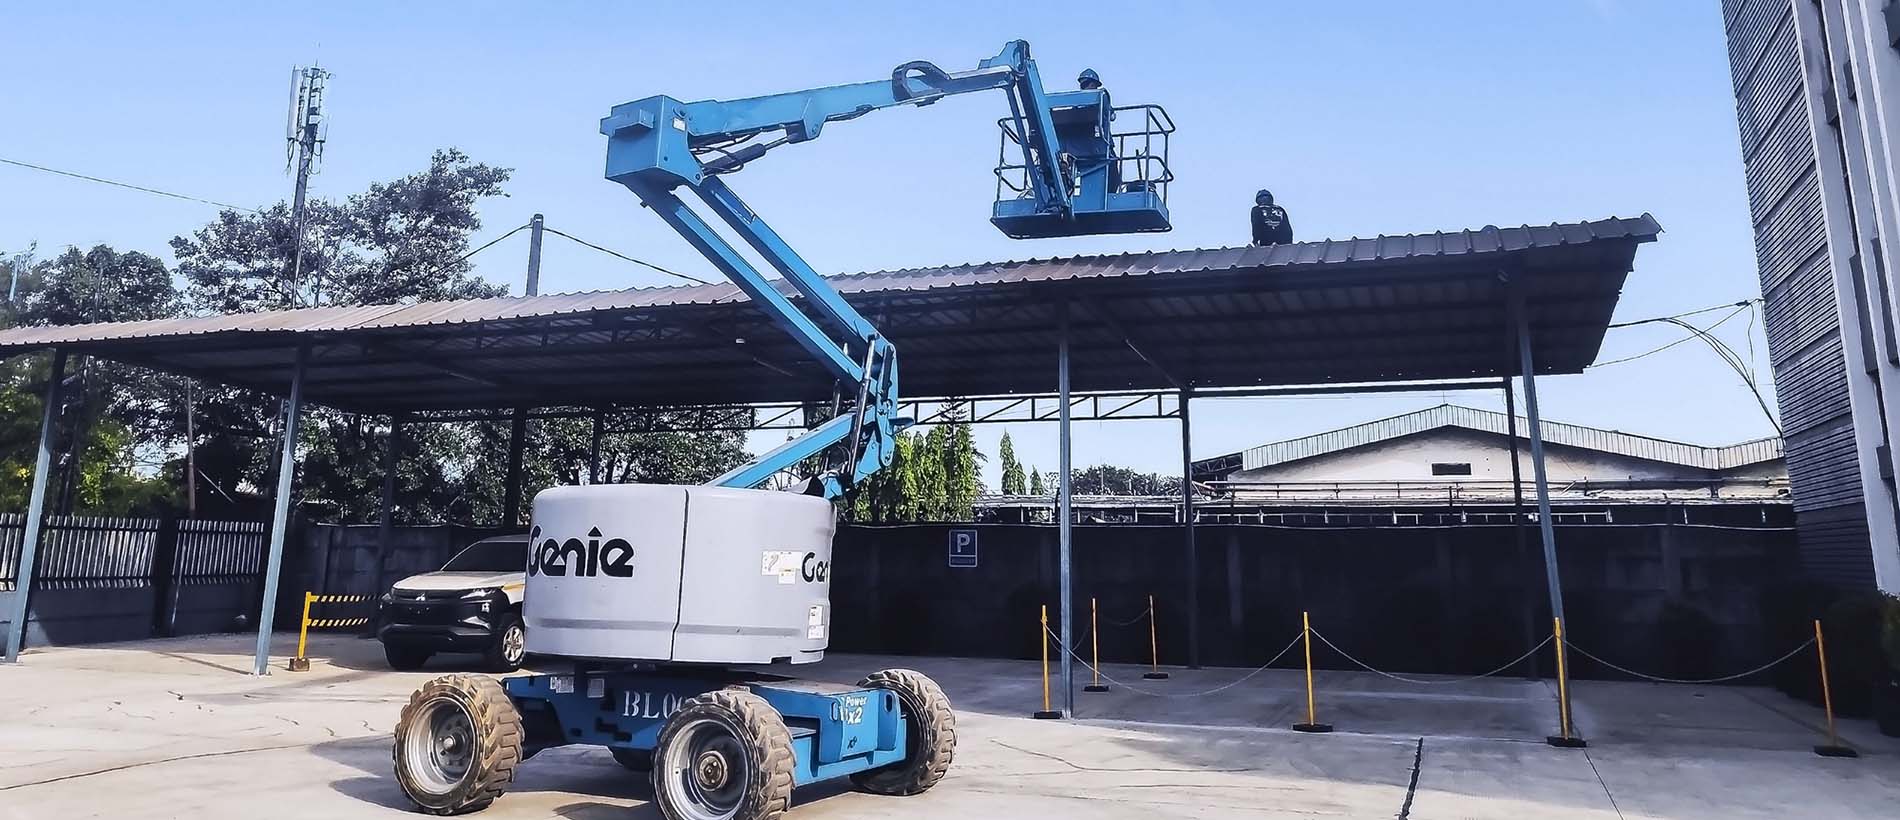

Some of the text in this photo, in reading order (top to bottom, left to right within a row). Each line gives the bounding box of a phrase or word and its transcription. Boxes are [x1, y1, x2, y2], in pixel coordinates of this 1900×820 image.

[527, 525, 635, 578] Genie
[957, 533, 970, 553] P
[845, 696, 868, 707] Power
